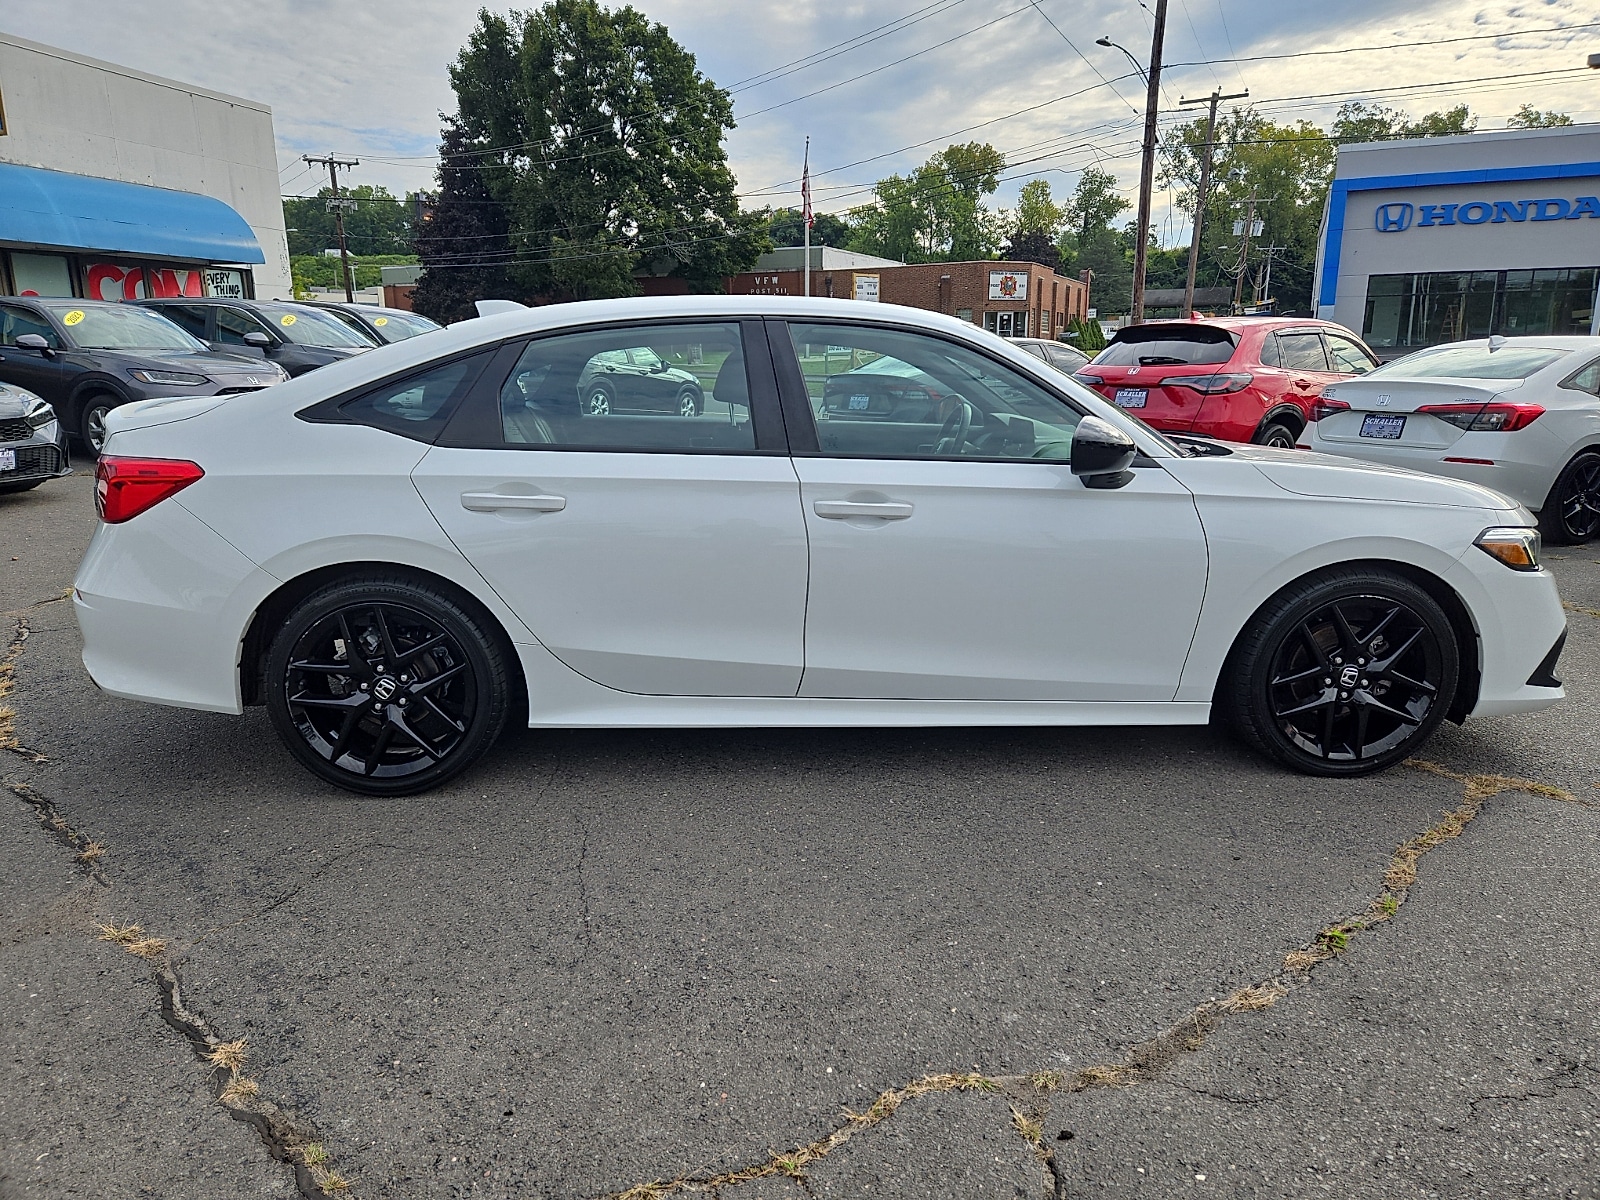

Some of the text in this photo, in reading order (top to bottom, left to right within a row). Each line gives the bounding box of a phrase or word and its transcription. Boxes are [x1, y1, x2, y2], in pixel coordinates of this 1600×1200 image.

[1418, 196, 1600, 227] HONDA
[206, 272, 230, 286] EVERY
[755, 276, 779, 285] VFW
[213, 285, 241, 295] THING
[1364, 417, 1404, 426] SCHALLER
